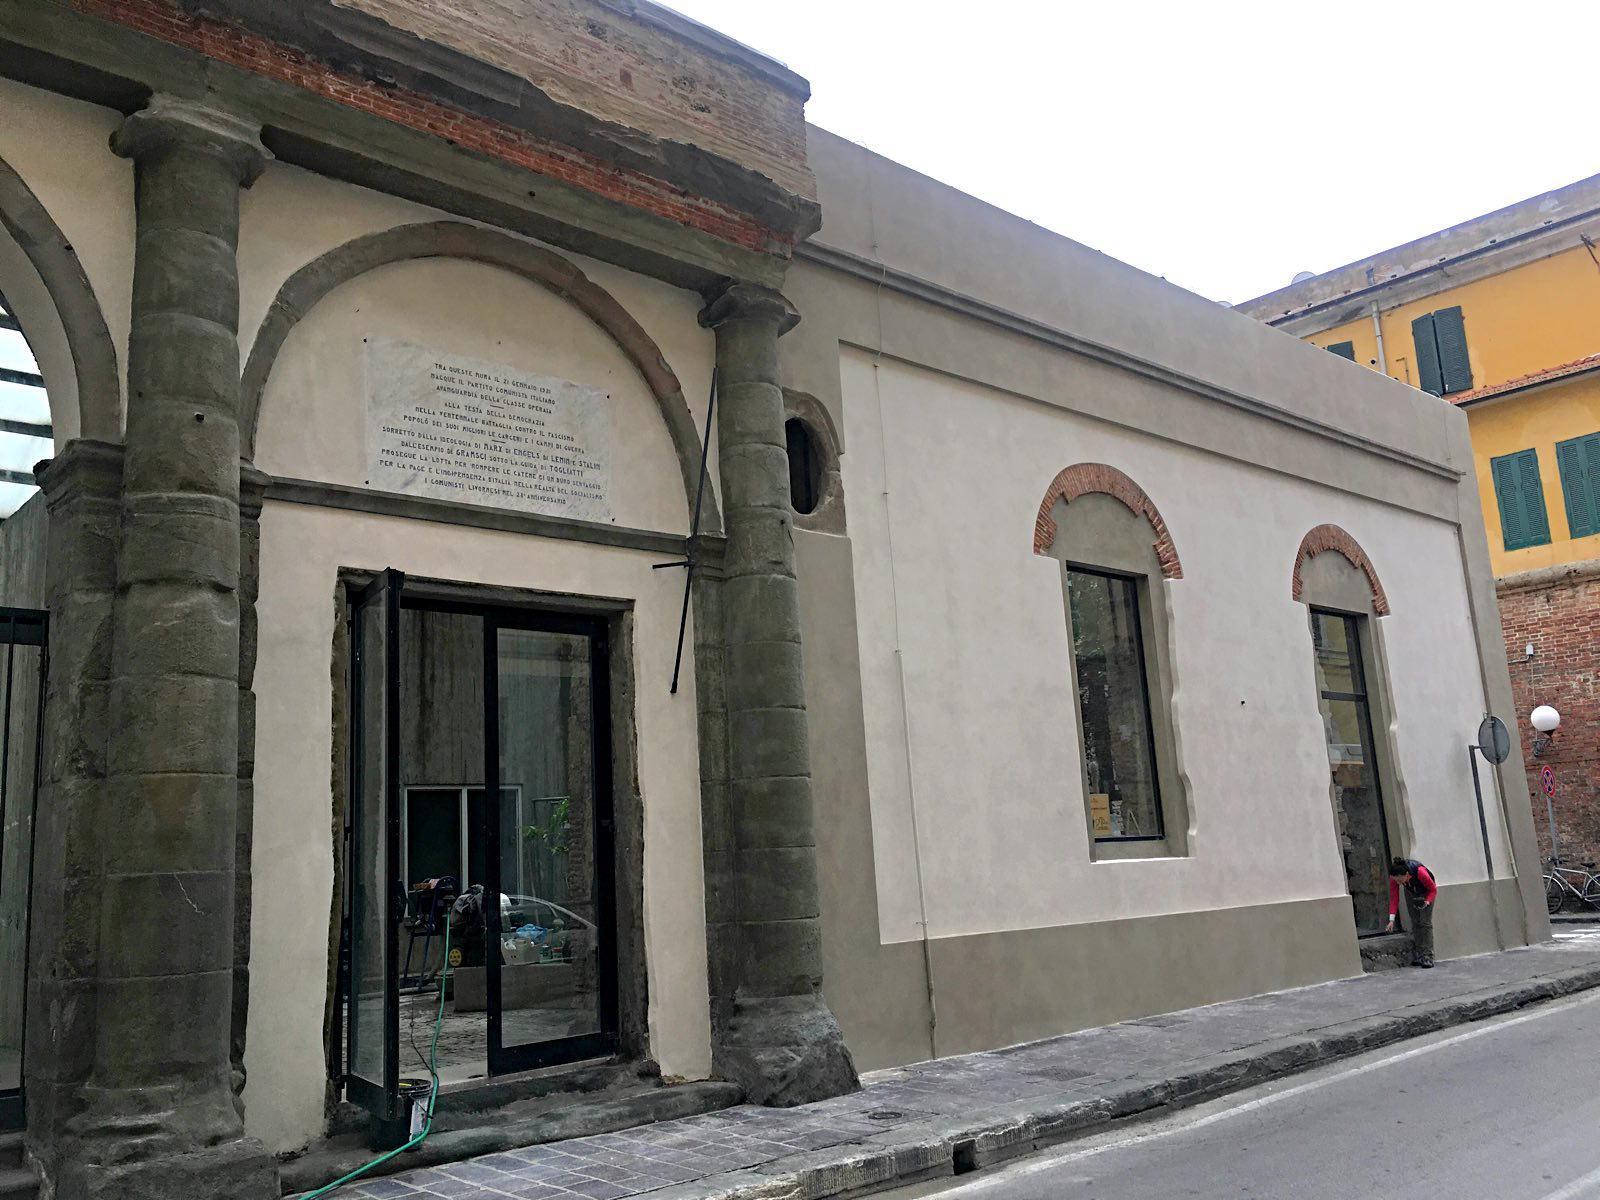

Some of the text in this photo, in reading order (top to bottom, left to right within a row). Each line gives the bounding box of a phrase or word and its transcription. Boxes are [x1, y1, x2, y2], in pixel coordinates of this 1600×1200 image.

[430, 373, 455, 383] NACQUE
[467, 381, 493, 391] PARTITO
[496, 387, 528, 399] COMUNISTA
[530, 395, 555, 405] ITALIANO
[435, 363, 446, 371] TRA
[449, 366, 472, 377] QUESTE
[476, 372, 491, 380] MURA
[512, 381, 537, 391] GENNAIO
[436, 385, 552, 414] AVANGUARDIA DELLA CLASSE OPERAIA
[415, 406, 435, 416] NELLA
[440, 411, 479, 423] VENTENNALE
[482, 420, 512, 430] BATTAGLIA
[515, 426, 537, 434] CONTRO
[548, 432, 574, 442] FASCISMO
[465, 405, 482, 414] TESTA
[487, 410, 506, 418] DELLA
[509, 414, 545, 426] DEMOCRAZIA
[382, 426, 415, 437] SORRETTO
[418, 432, 437, 441] DALLA
[440, 436, 471, 447] IDEOLOGIA
[484, 443, 503, 452] MARX
[513, 448, 540, 459] ENGELS
[551, 455, 570, 465] LENIN
[579, 460, 600, 470] STALIN
[432, 420, 442, 428] DEI
[462, 426, 486, 435] MIGLIORI
[498, 433, 522, 442] CARCERI
[536, 440, 554, 449] CAMPI
[564, 445, 584, 454] GUERRA
[381, 449, 417, 460] PROSEGUE
[432, 456, 451, 465] LOTTA
[455, 460, 467, 468] PER
[471, 463, 500, 473] ROMPERE
[513, 470, 536, 479] CATENE
[456, 449, 487, 460] GRAMSCI
[550, 465, 583, 477] TOGLIATTI
[409, 464, 425, 472] PACE
[514, 481, 532, 489] NELLA
[571, 490, 603, 500] SOCIALISMO
[430, 479, 464, 489] COMUNISTI
[468, 484, 500, 494] LIVORNESI
[527, 494, 566, 504] ANNIVERSARIO
